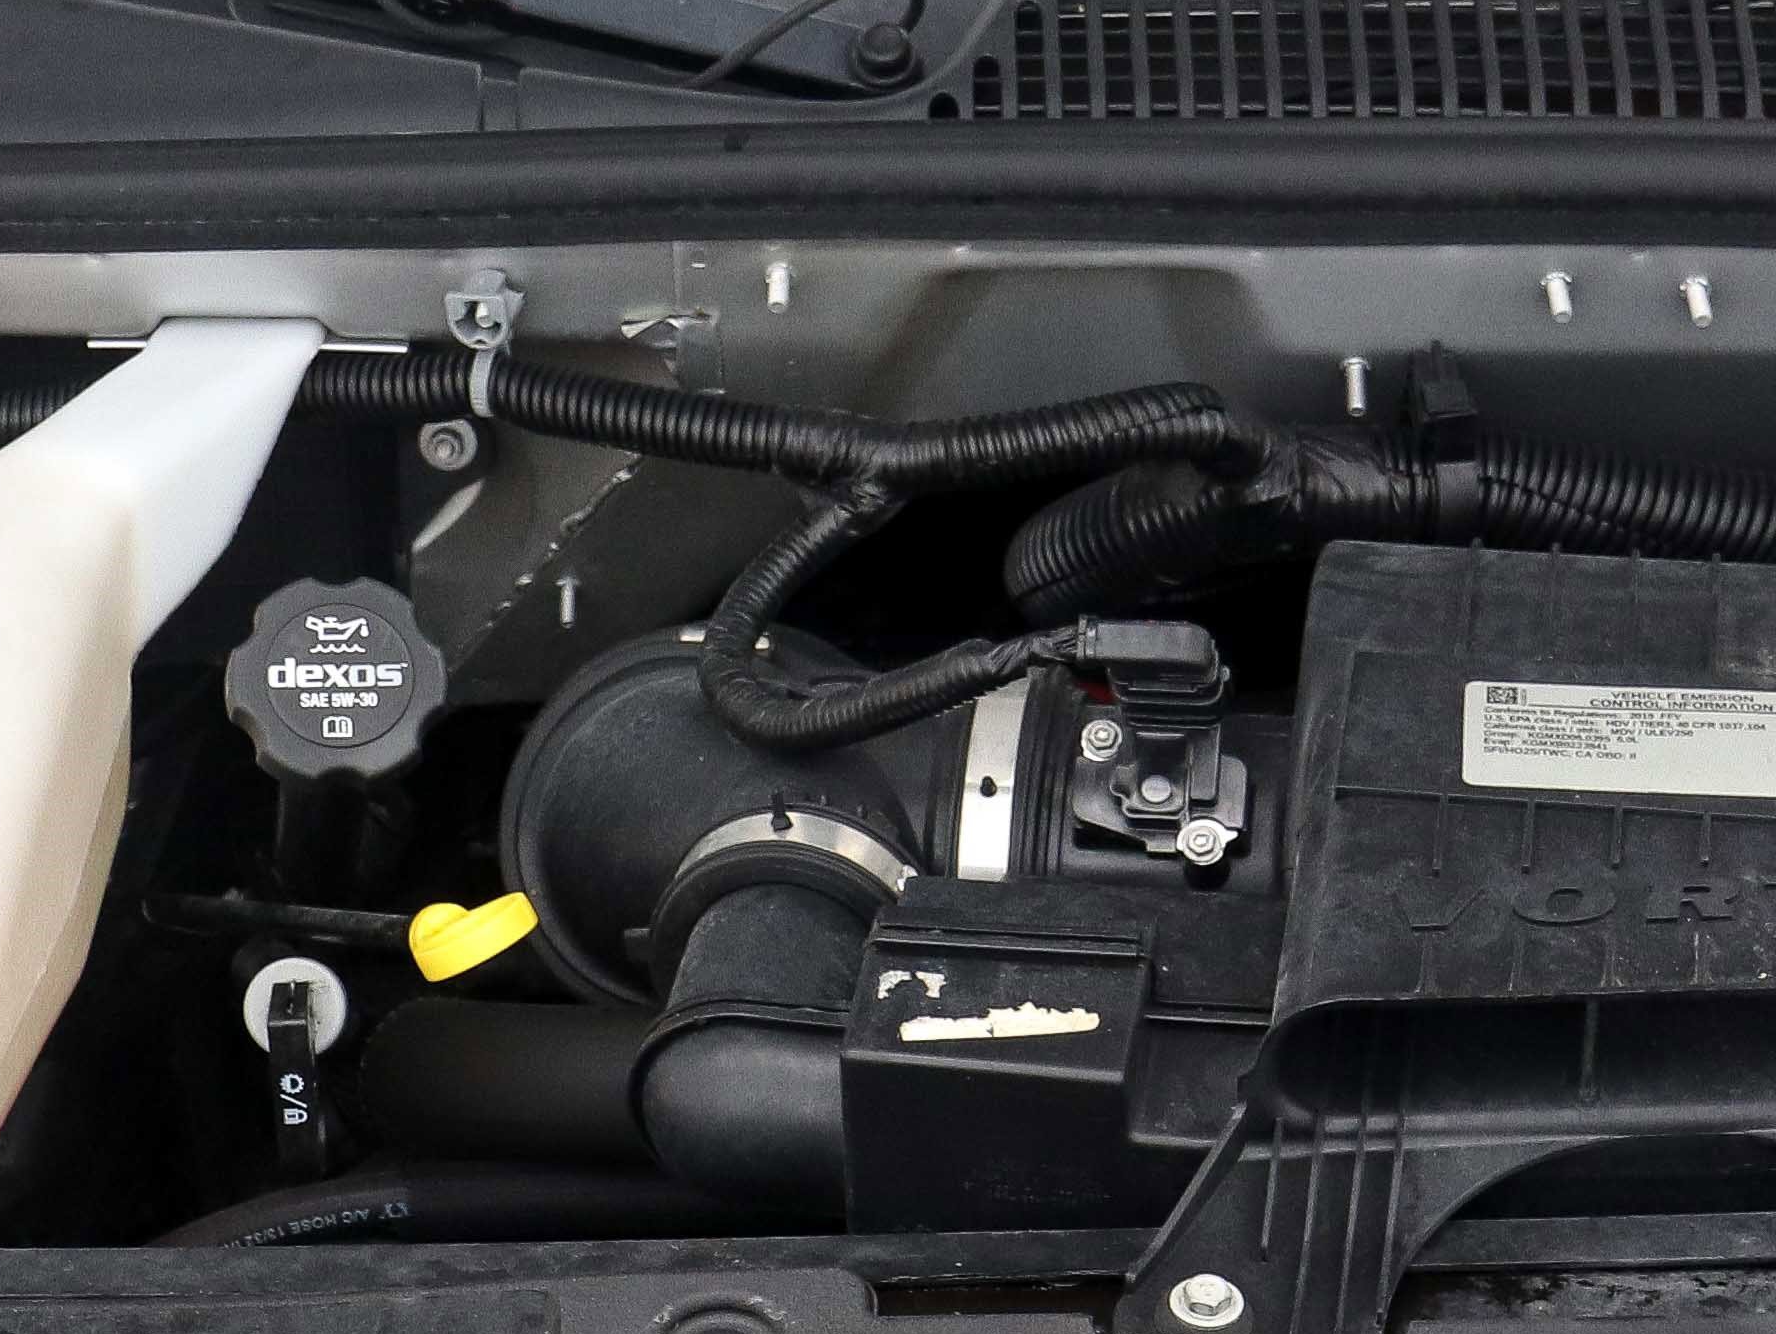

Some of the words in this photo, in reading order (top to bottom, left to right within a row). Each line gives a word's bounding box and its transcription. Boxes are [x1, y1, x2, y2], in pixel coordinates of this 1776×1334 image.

[267, 657, 404, 688] dexos
[299, 691, 329, 708] SAE
[331, 691, 379, 708] 5W-30
[1589, 698, 1661, 709] CONTROL
[1667, 700, 1774, 712] INFORMATION
[1610, 690, 1675, 701] VEHICLE
[1681, 693, 1755, 703] EMISSION
[287, 1213, 337, 1234] HOSE
